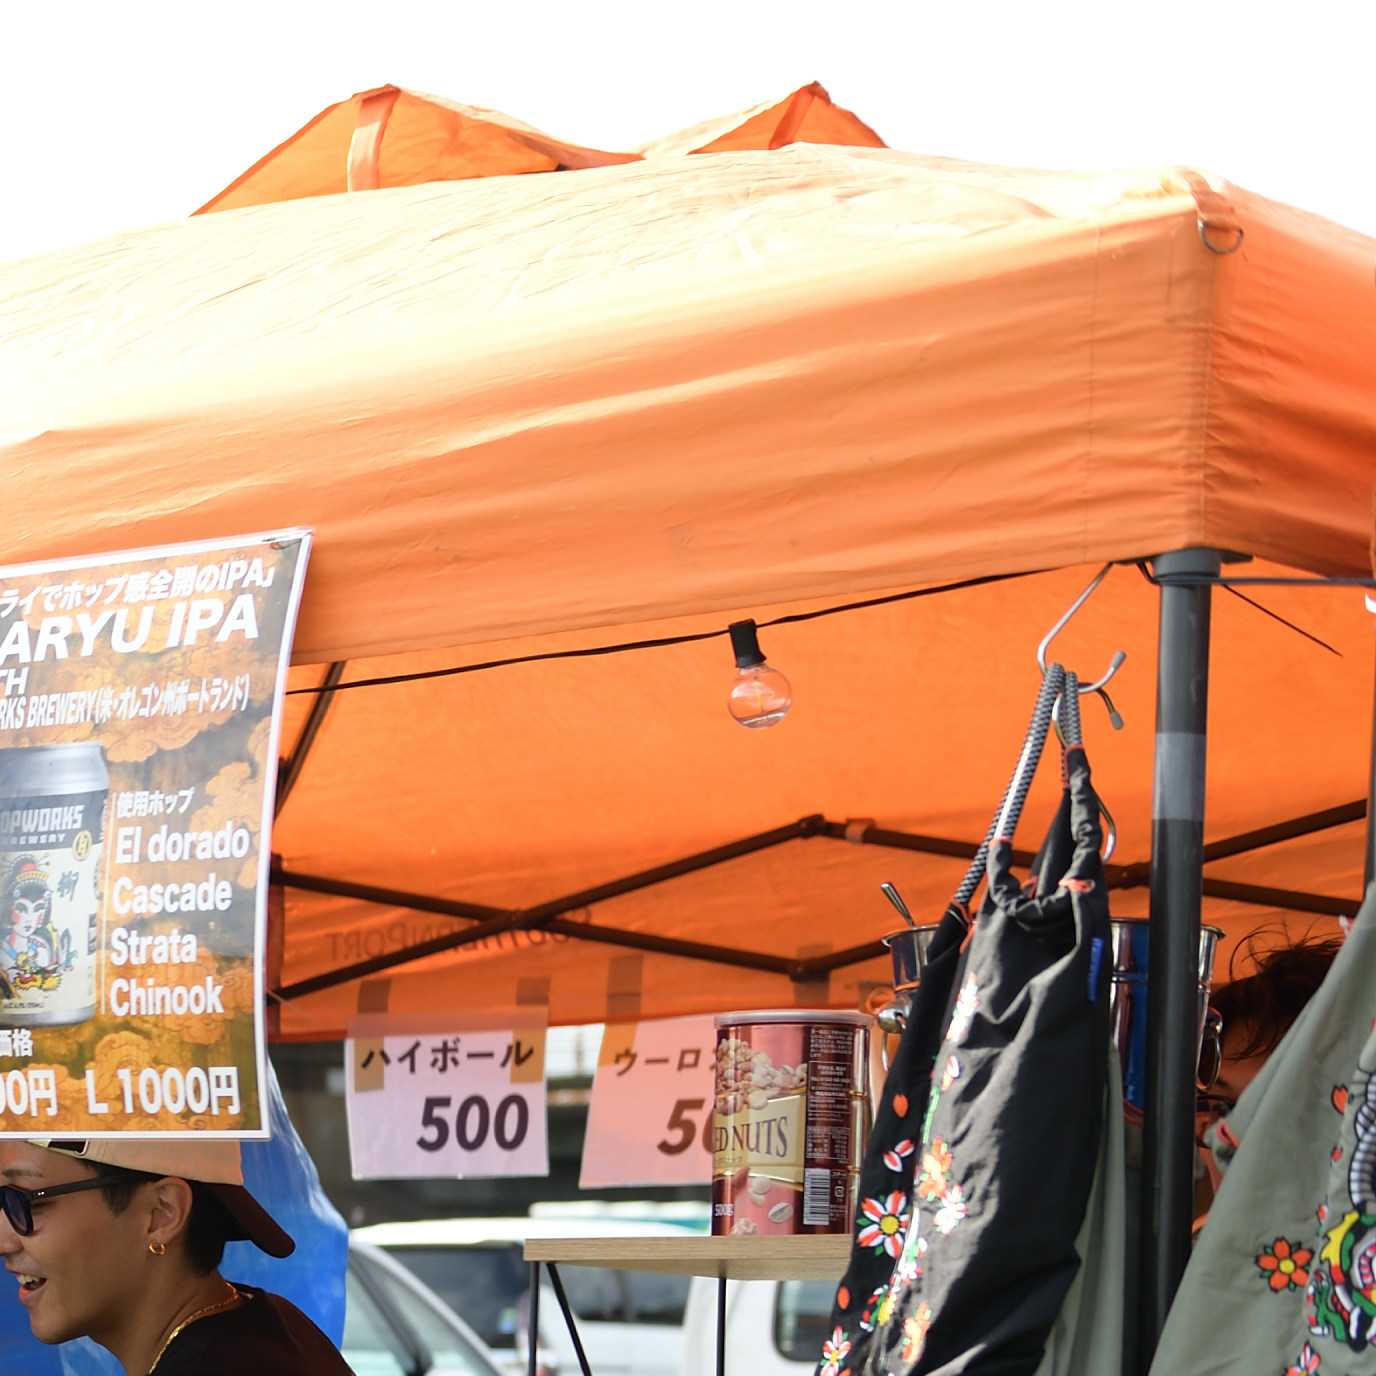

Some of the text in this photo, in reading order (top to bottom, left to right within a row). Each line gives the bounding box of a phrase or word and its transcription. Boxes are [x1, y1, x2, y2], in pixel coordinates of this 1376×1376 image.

[166, 594, 259, 648] IPA
[117, 787, 195, 819] 使用ホップ
[115, 820, 250, 864] El dorado
[112, 873, 232, 915] Cascade
[110, 927, 198, 966] Strata
[110, 977, 225, 1017] Chinook
[361, 1039, 535, 1076] ハイボール
[612, 1046, 715, 1078] ウーロ
[86, 1069, 109, 1115] L
[117, 1067, 242, 1116] 1000円
[416, 1094, 530, 1153] 500
[656, 1098, 714, 1156] 5
[732, 1116, 788, 1158] NUTS
